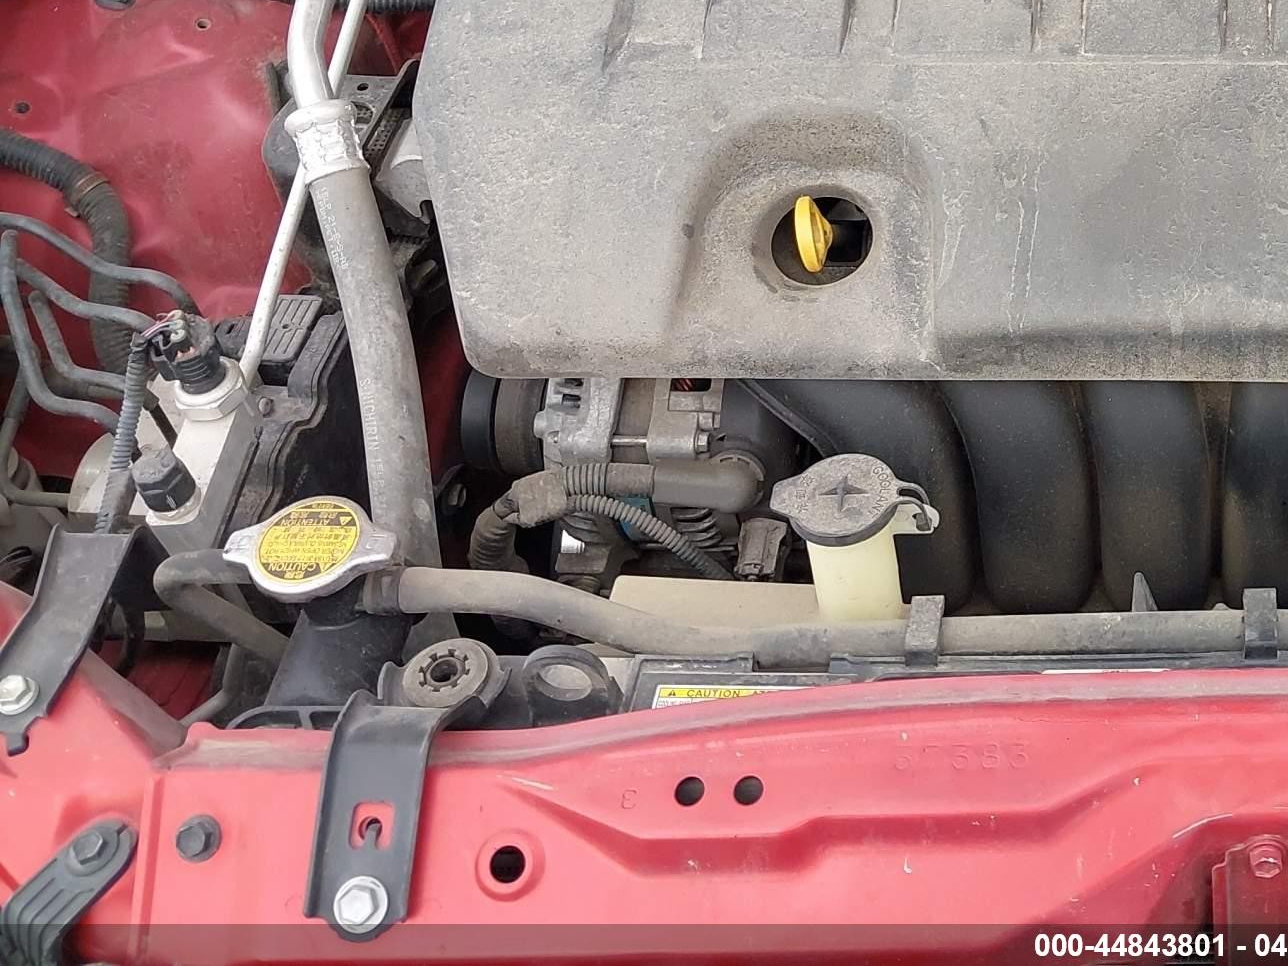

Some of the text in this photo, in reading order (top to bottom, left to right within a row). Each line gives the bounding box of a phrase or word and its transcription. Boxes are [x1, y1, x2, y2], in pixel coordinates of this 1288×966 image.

[281, 518, 330, 526] ATTENTION
[268, 563, 316, 571] CAUTION
[686, 689, 741, 698] CAUTION
